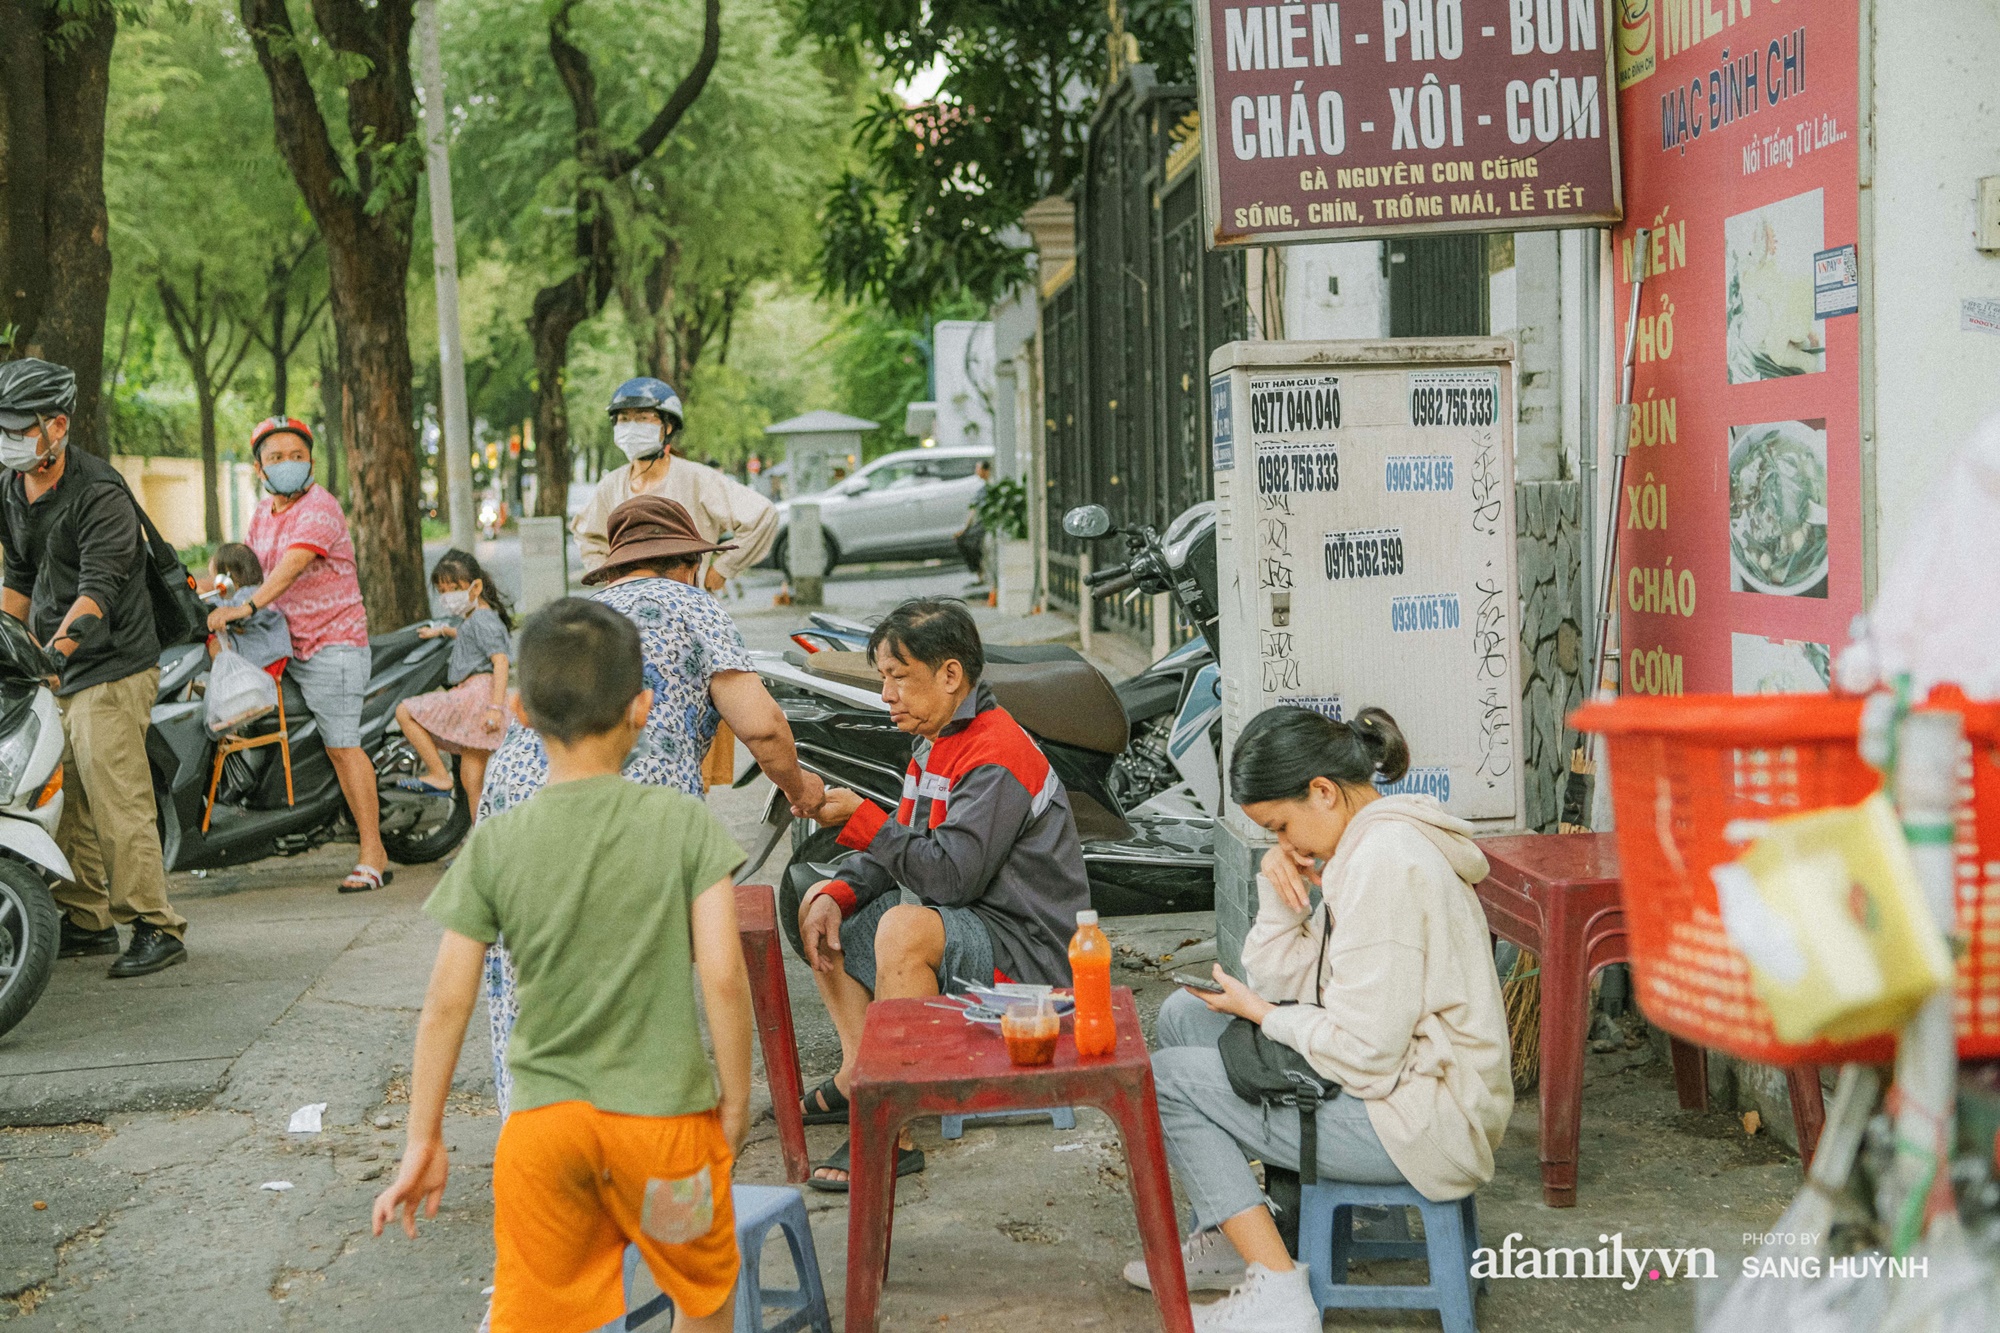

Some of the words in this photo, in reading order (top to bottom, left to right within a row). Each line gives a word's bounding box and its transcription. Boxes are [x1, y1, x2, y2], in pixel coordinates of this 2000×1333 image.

[1230, 80, 1346, 160] CHÁO
[1388, 72, 1464, 150] XÔI
[1505, 69, 1600, 145] CƠM
[1662, 78, 1703, 157] MẠC
[1766, 26, 1805, 107] CHI
[1743, 133, 1760, 176] Nổi
[1763, 126, 1793, 169] Tiếng
[1796, 120, 1812, 156] Từ
[1300, 166, 1329, 191] GÀ
[1337, 161, 1425, 190] NGUYÊN
[1431, 161, 1474, 183] CON
[1234, 201, 1300, 228] SỐNG,
[1308, 198, 1364, 224] CHÍN,
[1373, 192, 1443, 220] TRỐNG
[1450, 190, 1501, 216] MÁI,
[1509, 183, 1535, 211] LỄ
[1543, 182, 1585, 209] TẾT
[1412, 387, 1492, 427] 0982.756.333
[1630, 387, 1677, 448] BÚN
[1258, 452, 1339, 494] 0982.756.333
[1386, 461, 1454, 492] 0909.354.956
[1627, 472, 1667, 530] XÔI
[1324, 537, 1404, 580] 0976.562.599
[1628, 556, 1696, 617] CHÁO
[1391, 598, 1460, 632] 0938.005.700
[1630, 644, 1684, 698] CƠM
